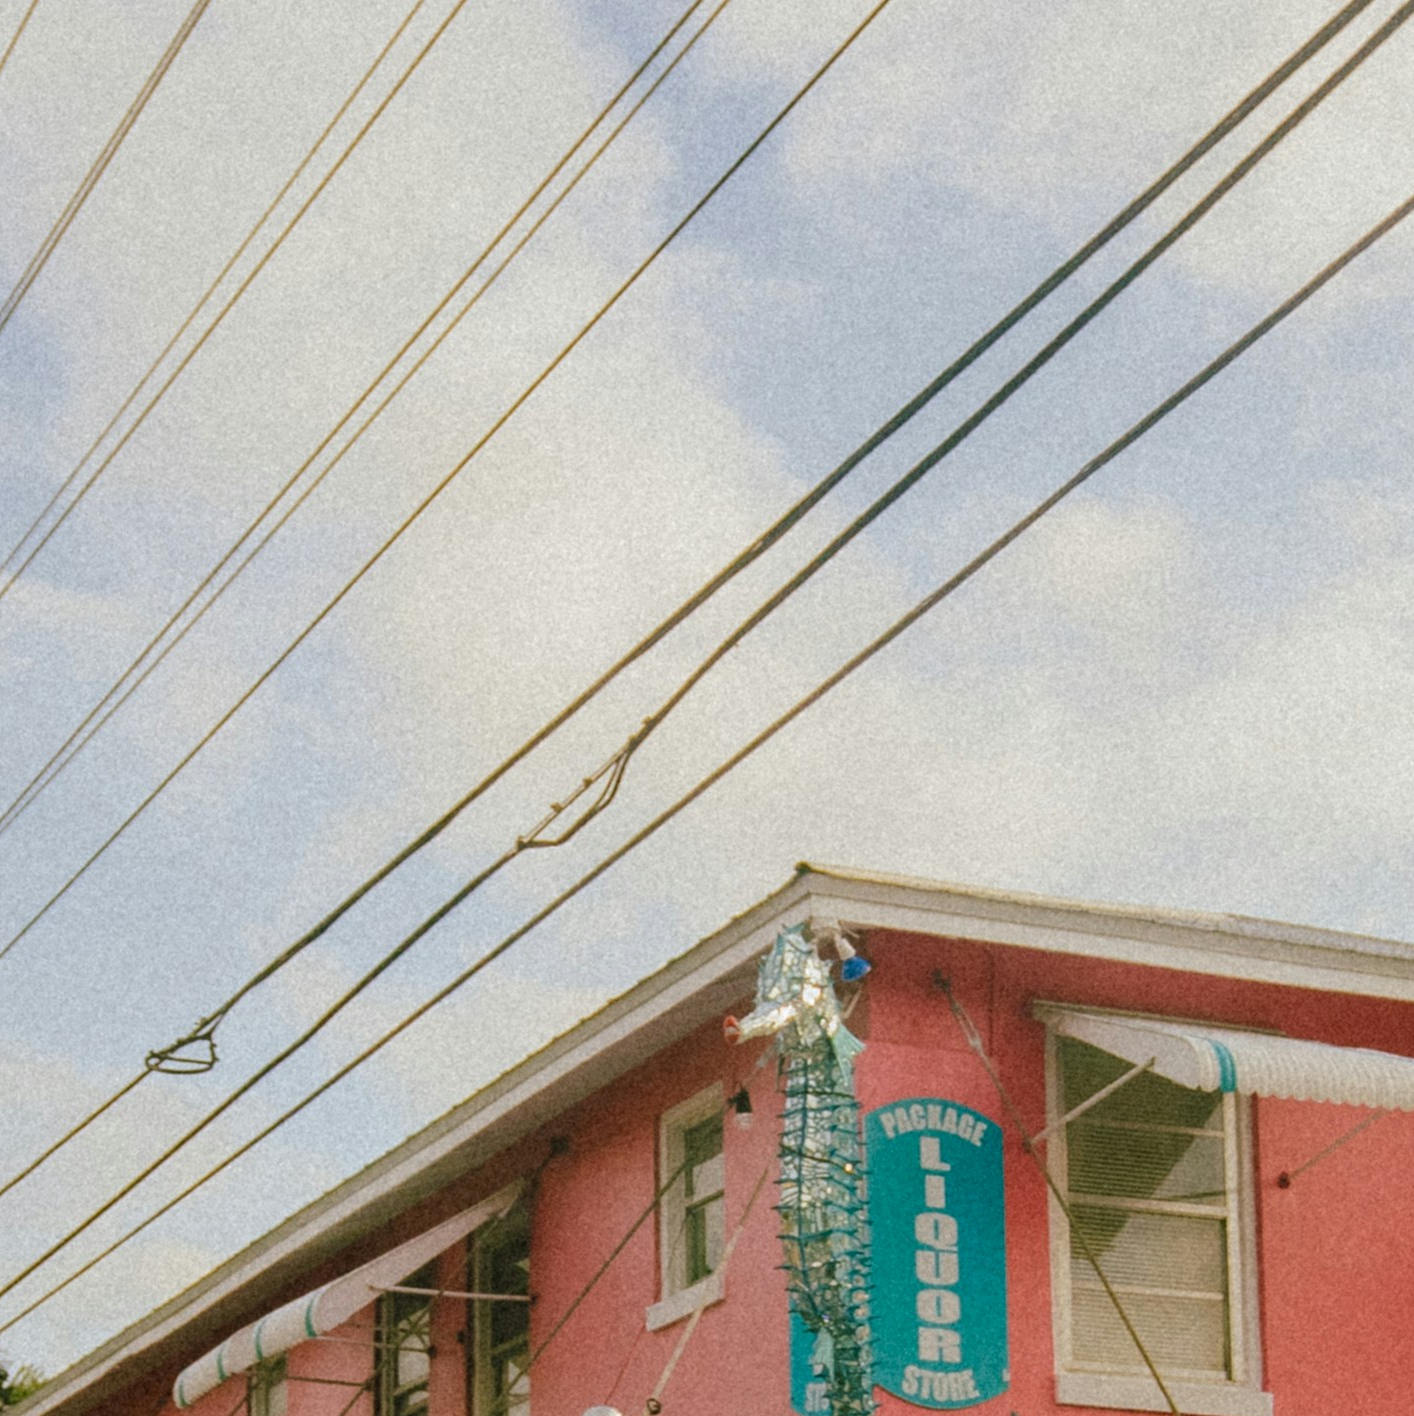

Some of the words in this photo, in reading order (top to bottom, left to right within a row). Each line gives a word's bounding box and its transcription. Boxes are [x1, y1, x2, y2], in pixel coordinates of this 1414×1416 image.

[880, 1103, 987, 1147] PACKAGE
[914, 1135, 961, 1363] LIQUOR
[901, 1364, 980, 1401] STORE
